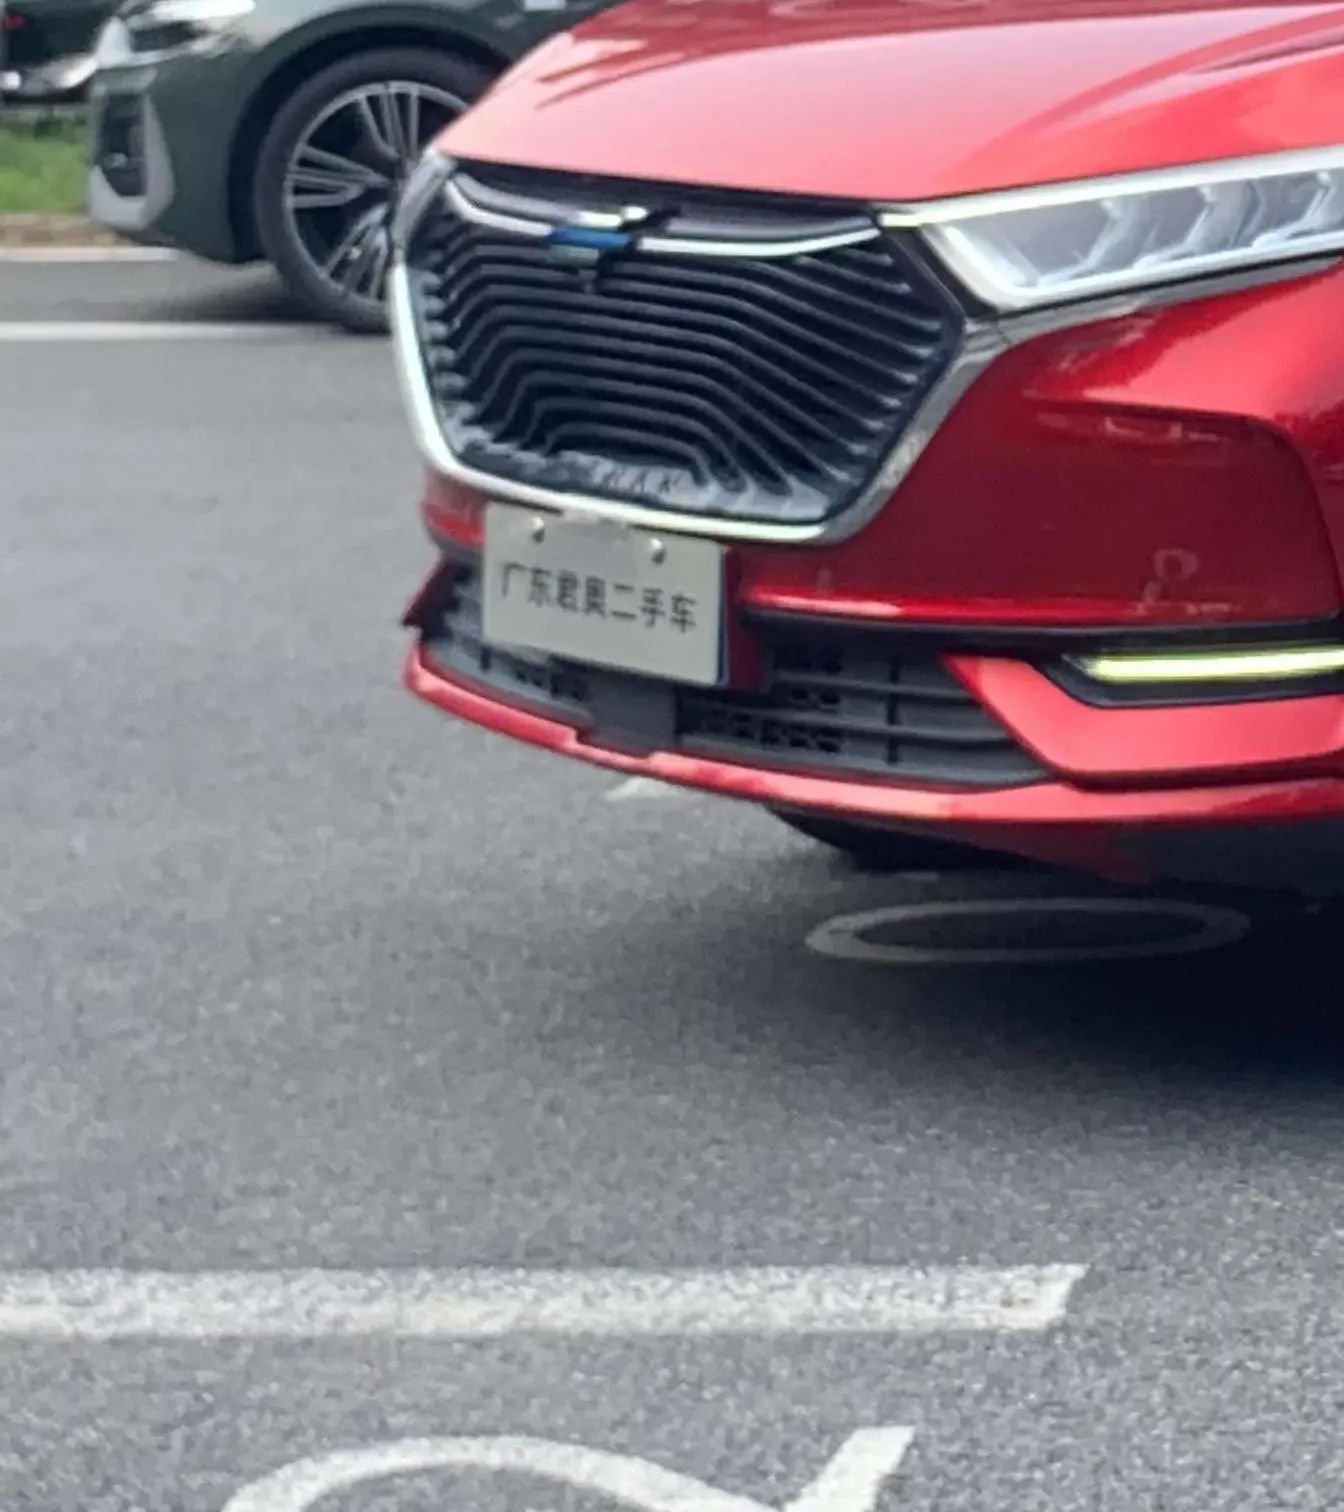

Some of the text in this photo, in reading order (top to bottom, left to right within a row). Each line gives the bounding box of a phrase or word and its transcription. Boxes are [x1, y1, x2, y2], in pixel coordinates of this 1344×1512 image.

[501, 561, 698, 635] 广东君奥二手车
